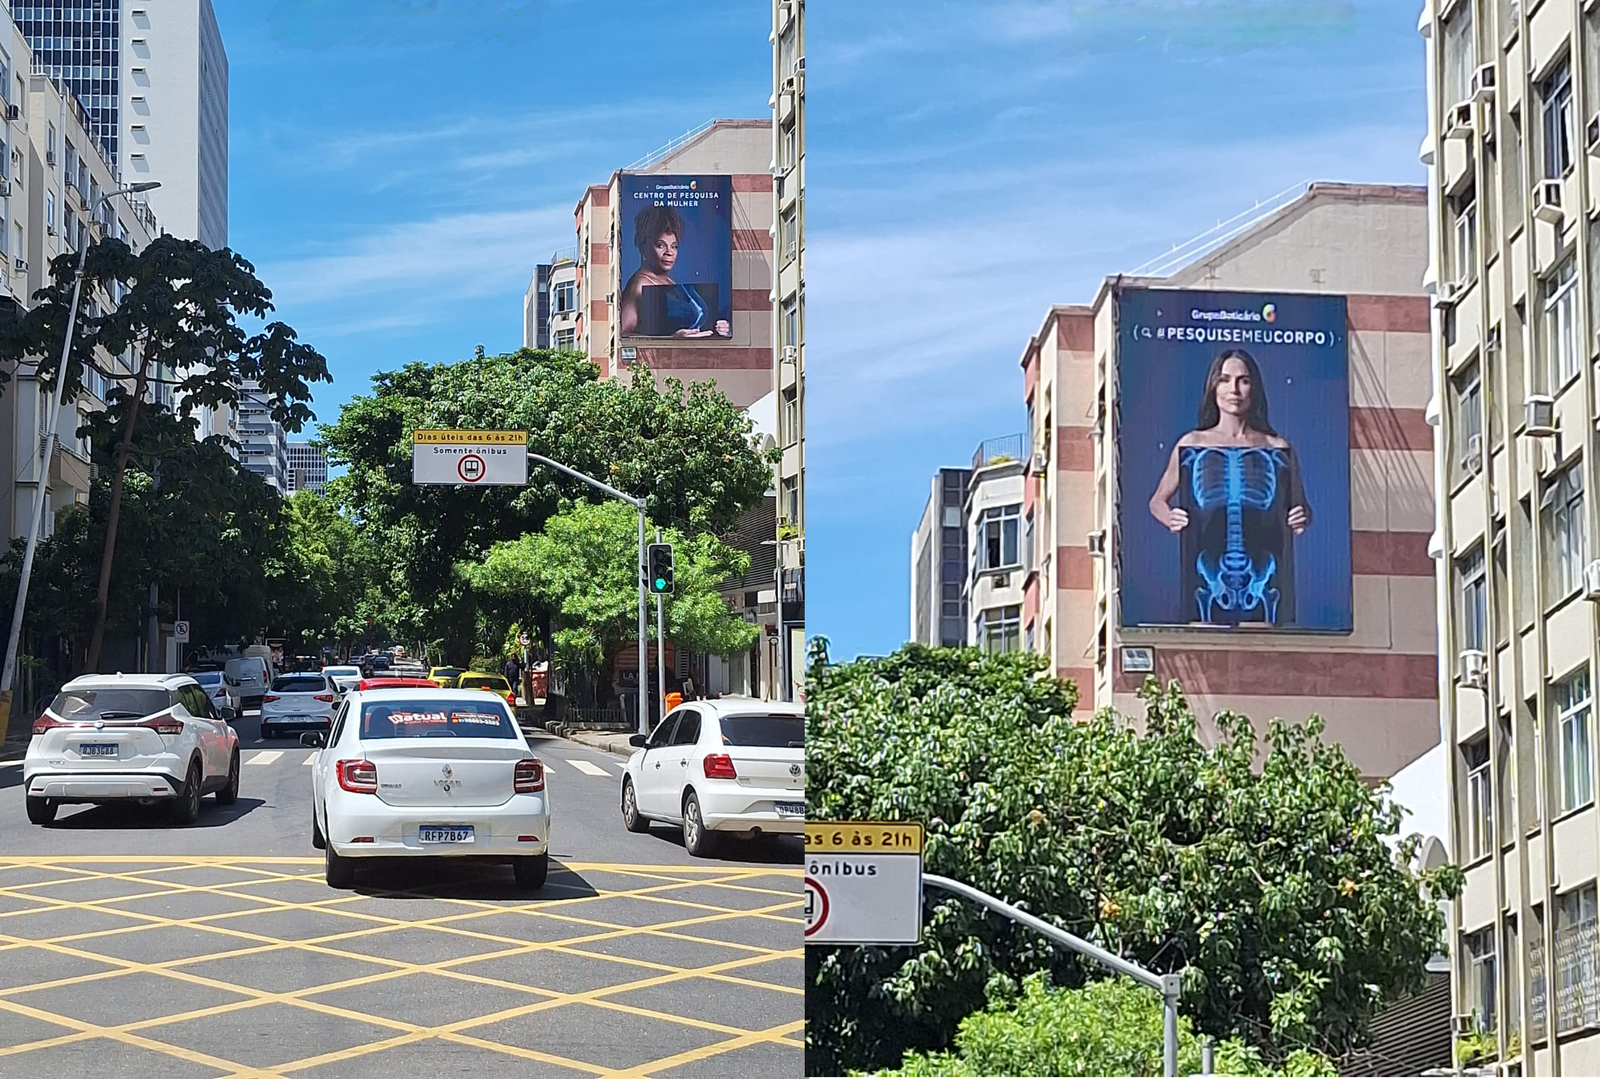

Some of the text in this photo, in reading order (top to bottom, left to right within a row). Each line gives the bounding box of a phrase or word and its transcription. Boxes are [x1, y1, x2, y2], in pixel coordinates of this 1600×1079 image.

[680, 192, 719, 200] PESQUISA
[417, 433, 437, 441] Dias
[441, 432, 464, 441] úteis
[467, 433, 483, 441] das
[495, 433, 505, 441] às
[433, 446, 507, 455] Somente ônibus
[424, 831, 469, 841] RFP7B67
[832, 831, 843, 846] 6
[851, 830, 873, 846] às
[881, 832, 912, 847] 21h
[809, 860, 877, 876] ônibus
